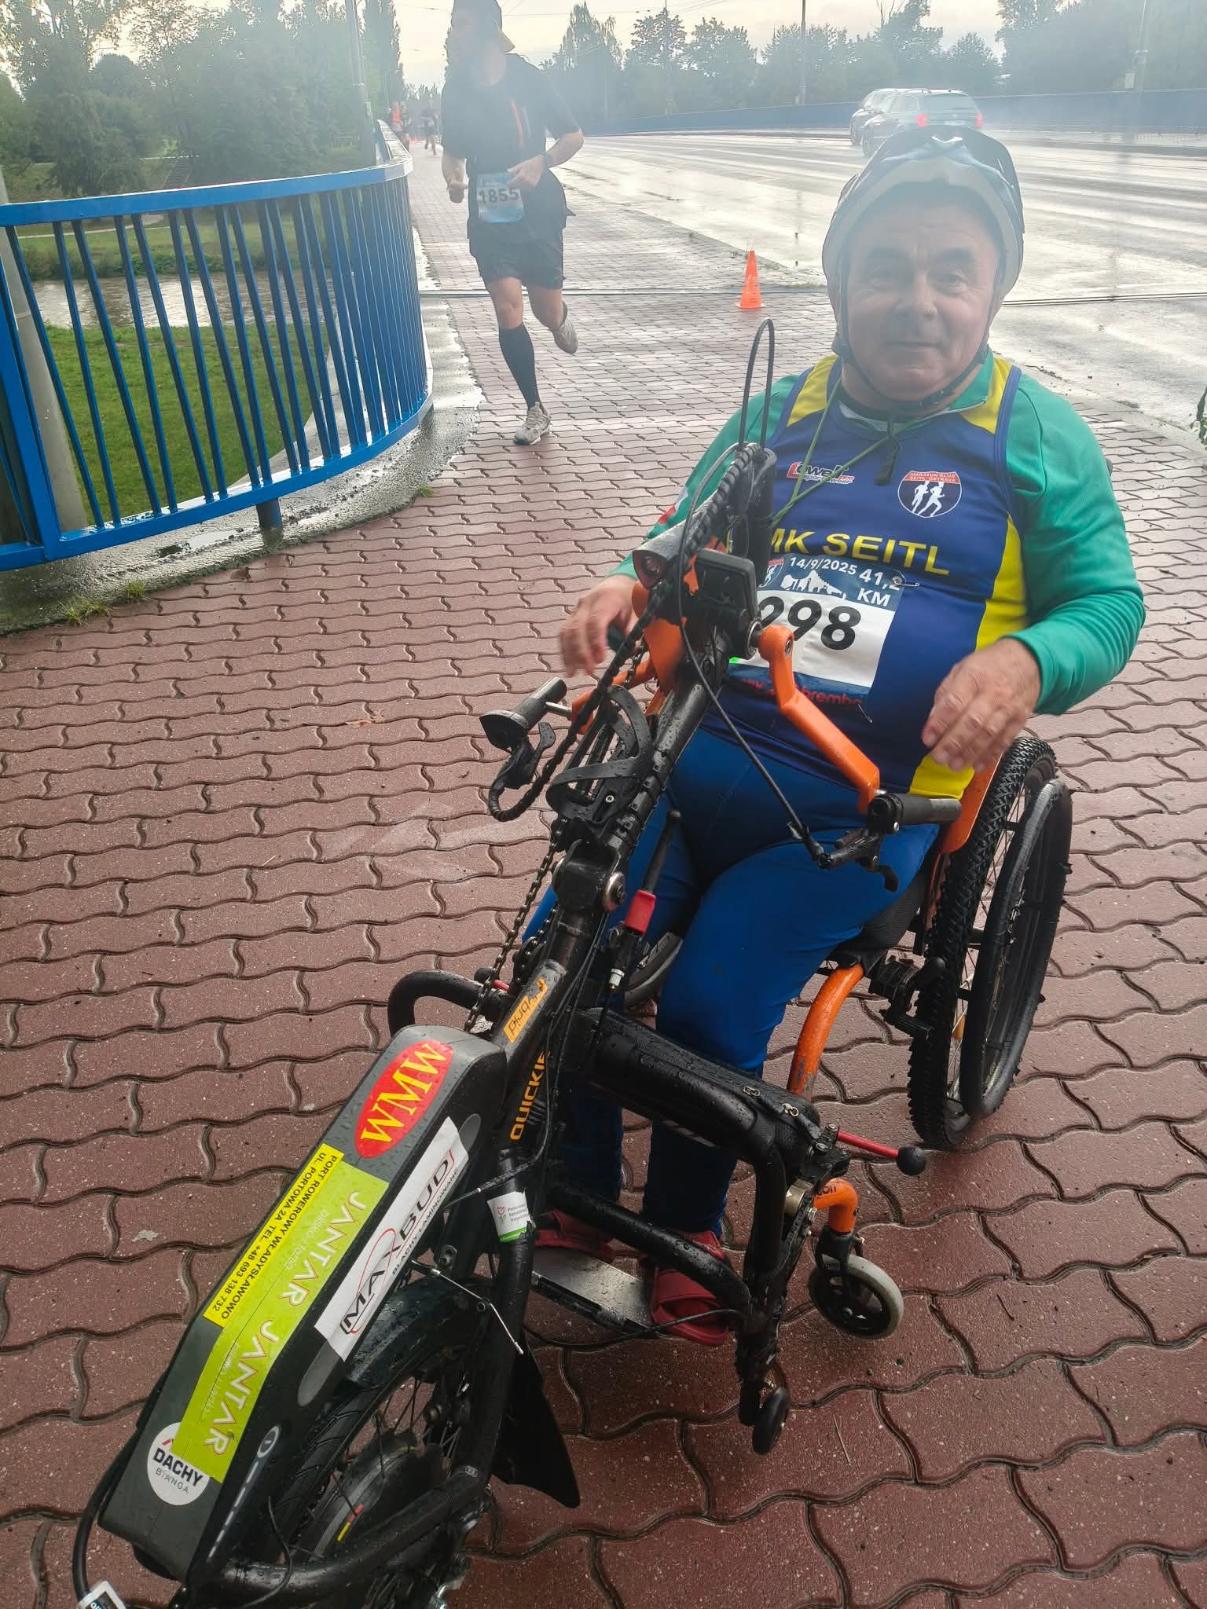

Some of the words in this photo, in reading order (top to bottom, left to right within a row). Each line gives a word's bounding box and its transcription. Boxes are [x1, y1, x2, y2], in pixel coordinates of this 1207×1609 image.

[478, 188, 520, 204] 1855
[790, 556, 858, 575] 14/9/2025
[822, 532, 950, 577] SEITL
[856, 586, 891, 607] KM
[319, 1154, 338, 1180] PORT
[282, 1167, 316, 1210] PORTOWA
[275, 1207, 287, 1222] 2A
[280, 1180, 321, 1236] ROWEROWY
[248, 1244, 262, 1261] +48
[280, 1191, 368, 1307] JANTAR
[220, 1234, 283, 1320] WŁADYSŁAWOWO
[237, 1261, 251, 1279] 693
[224, 1278, 239, 1295] 138
[213, 1295, 227, 1313] 732
[204, 1319, 280, 1456] JANTAR
[152, 1447, 204, 1487] DACHY
